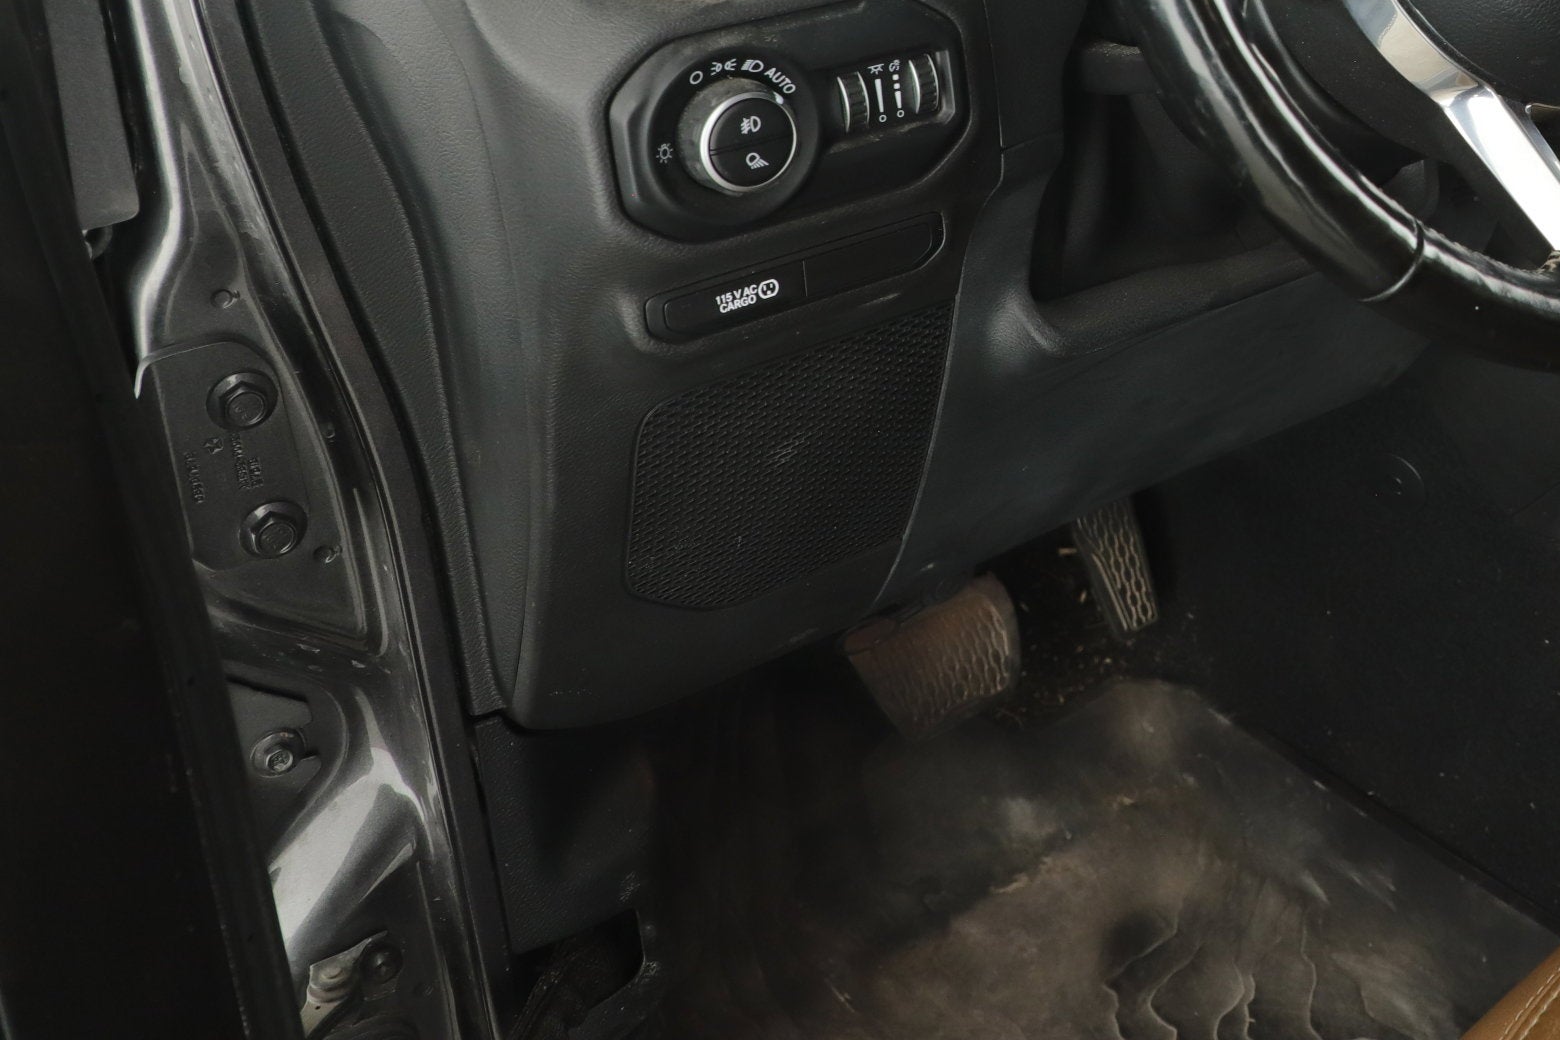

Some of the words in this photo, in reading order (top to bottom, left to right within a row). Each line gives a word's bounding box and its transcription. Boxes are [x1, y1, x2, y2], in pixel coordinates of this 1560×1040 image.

[763, 67, 797, 95] AUTO
[715, 292, 733, 306] 115
[743, 284, 758, 298] AC
[719, 294, 757, 314] CARGO
